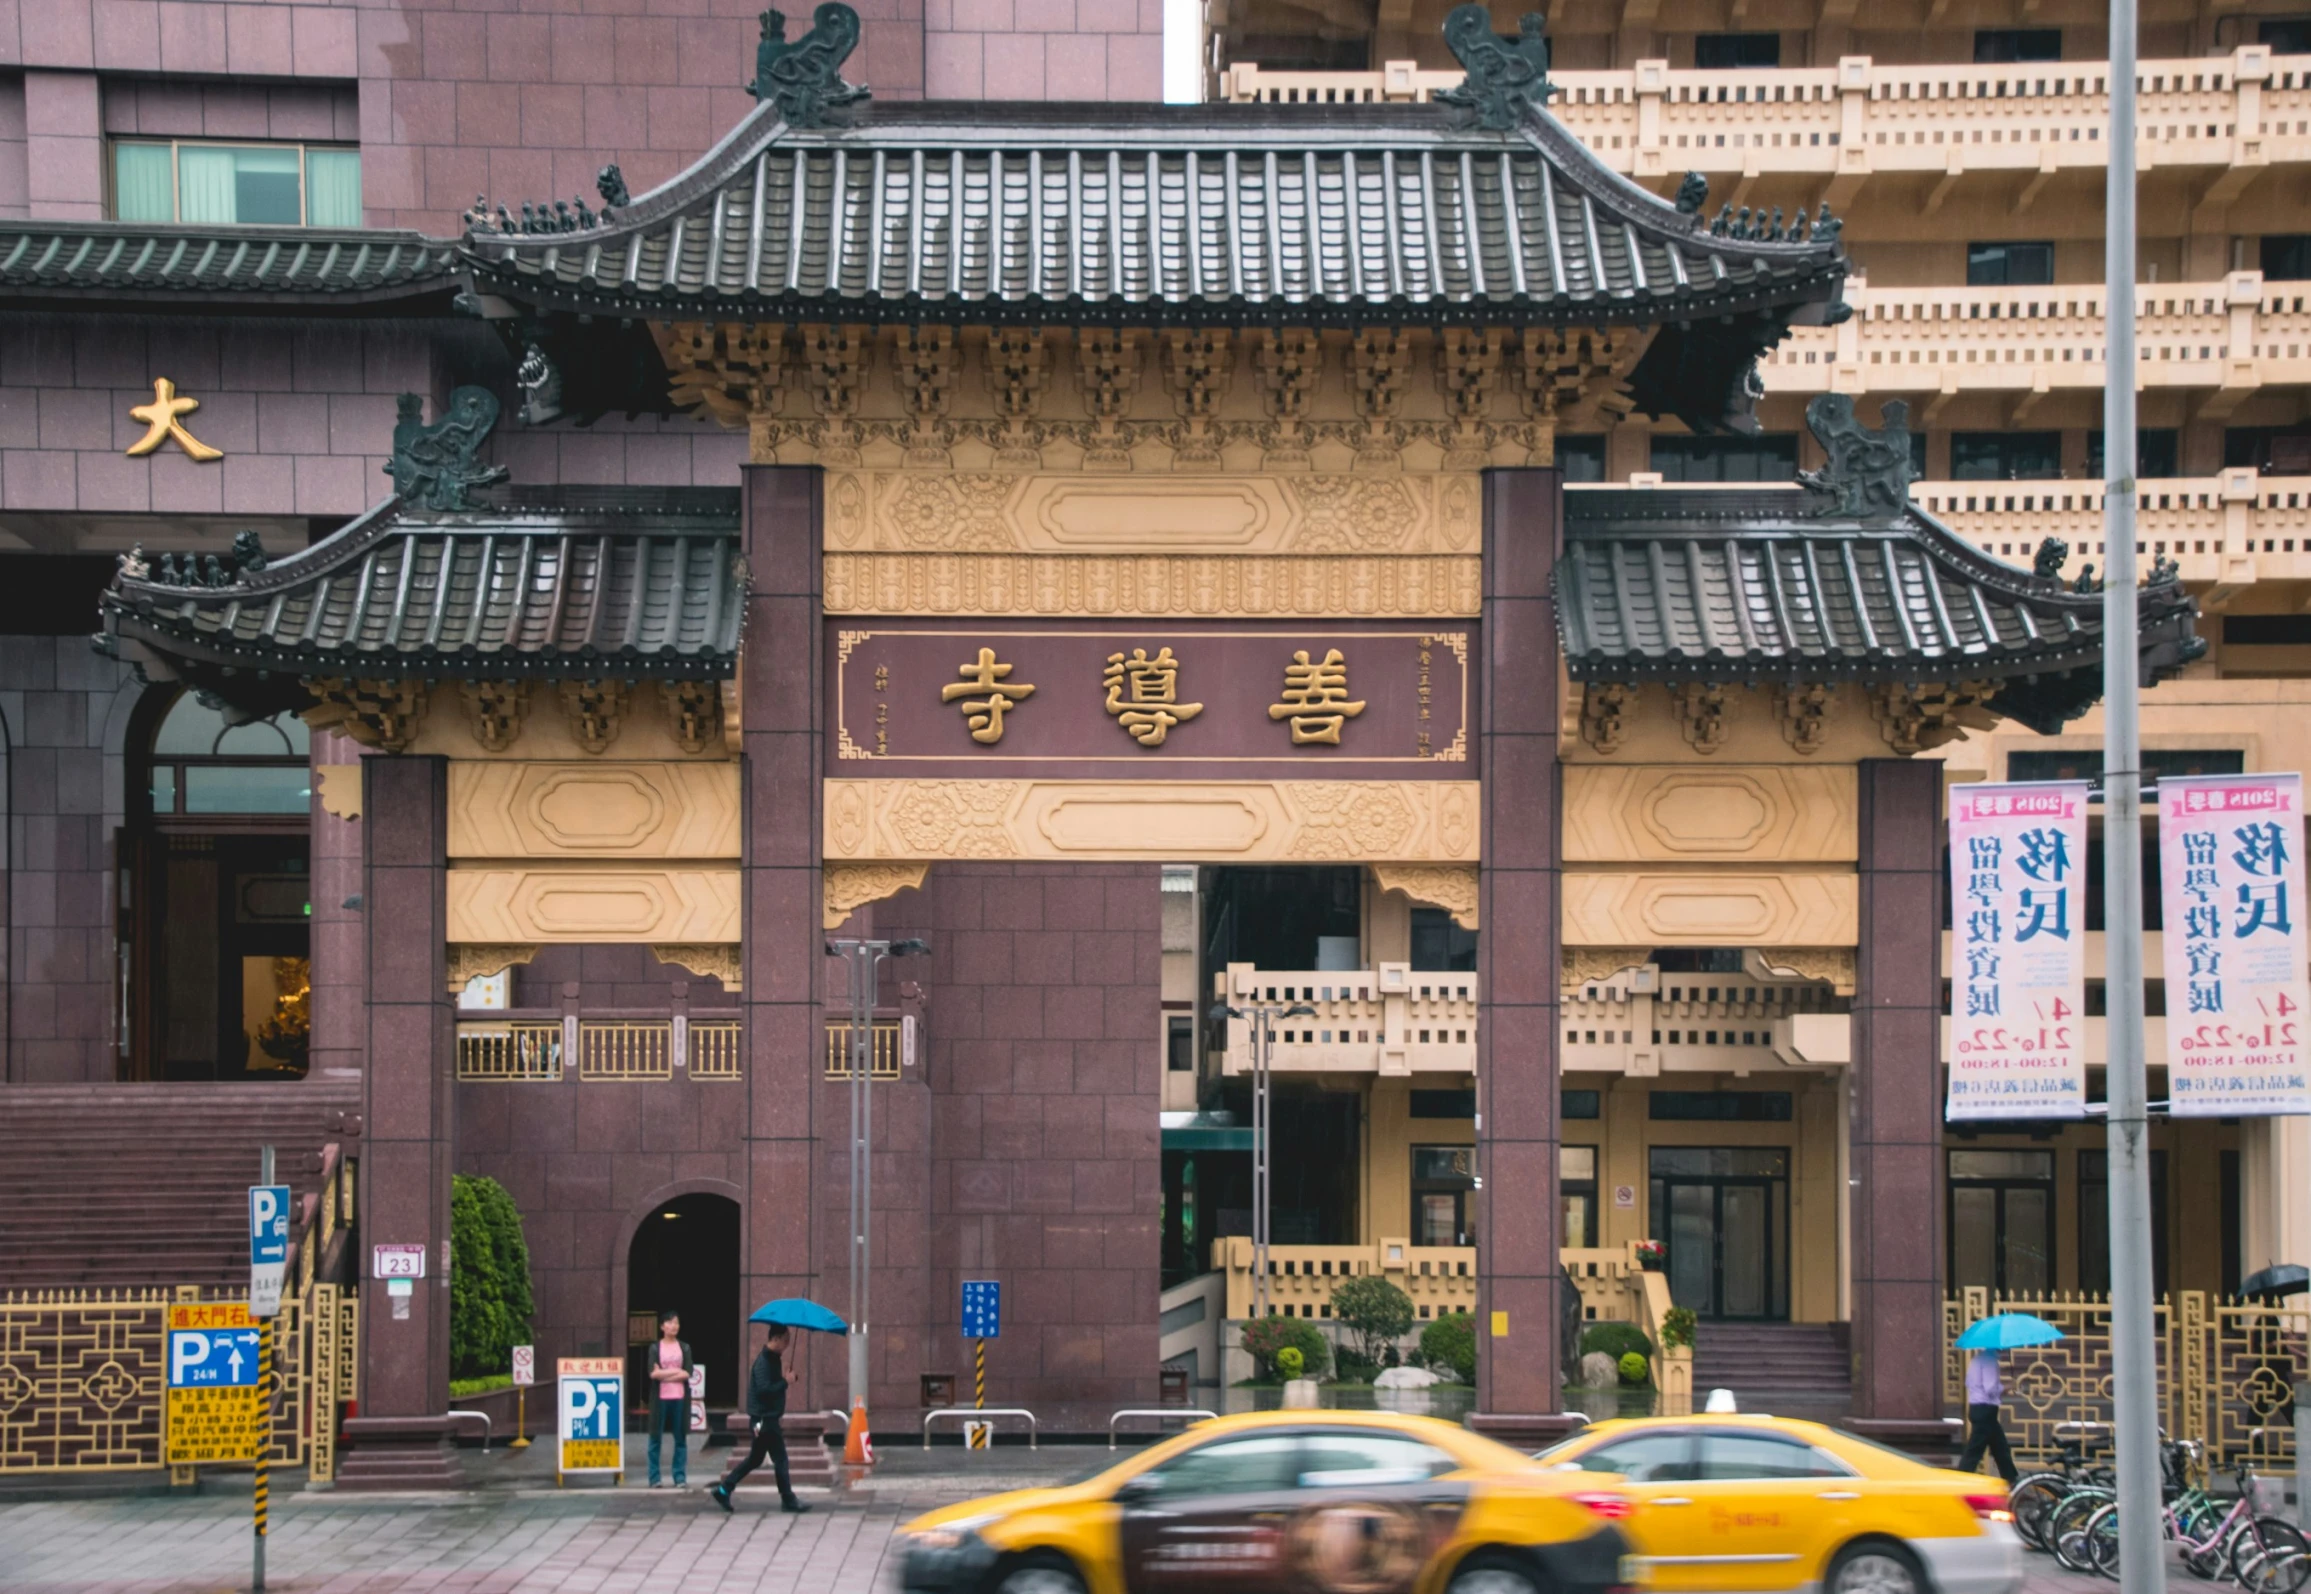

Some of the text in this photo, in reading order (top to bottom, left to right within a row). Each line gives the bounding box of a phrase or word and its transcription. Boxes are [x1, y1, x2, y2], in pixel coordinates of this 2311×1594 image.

[126, 376, 224, 461] 大
[941, 646, 1367, 747] 善導寺
[252, 1189, 277, 1238] P
[390, 1257, 412, 1273] 23
[174, 1306, 259, 1327] 進大門右
[172, 1332, 211, 1385] P
[562, 1379, 597, 1440] P
